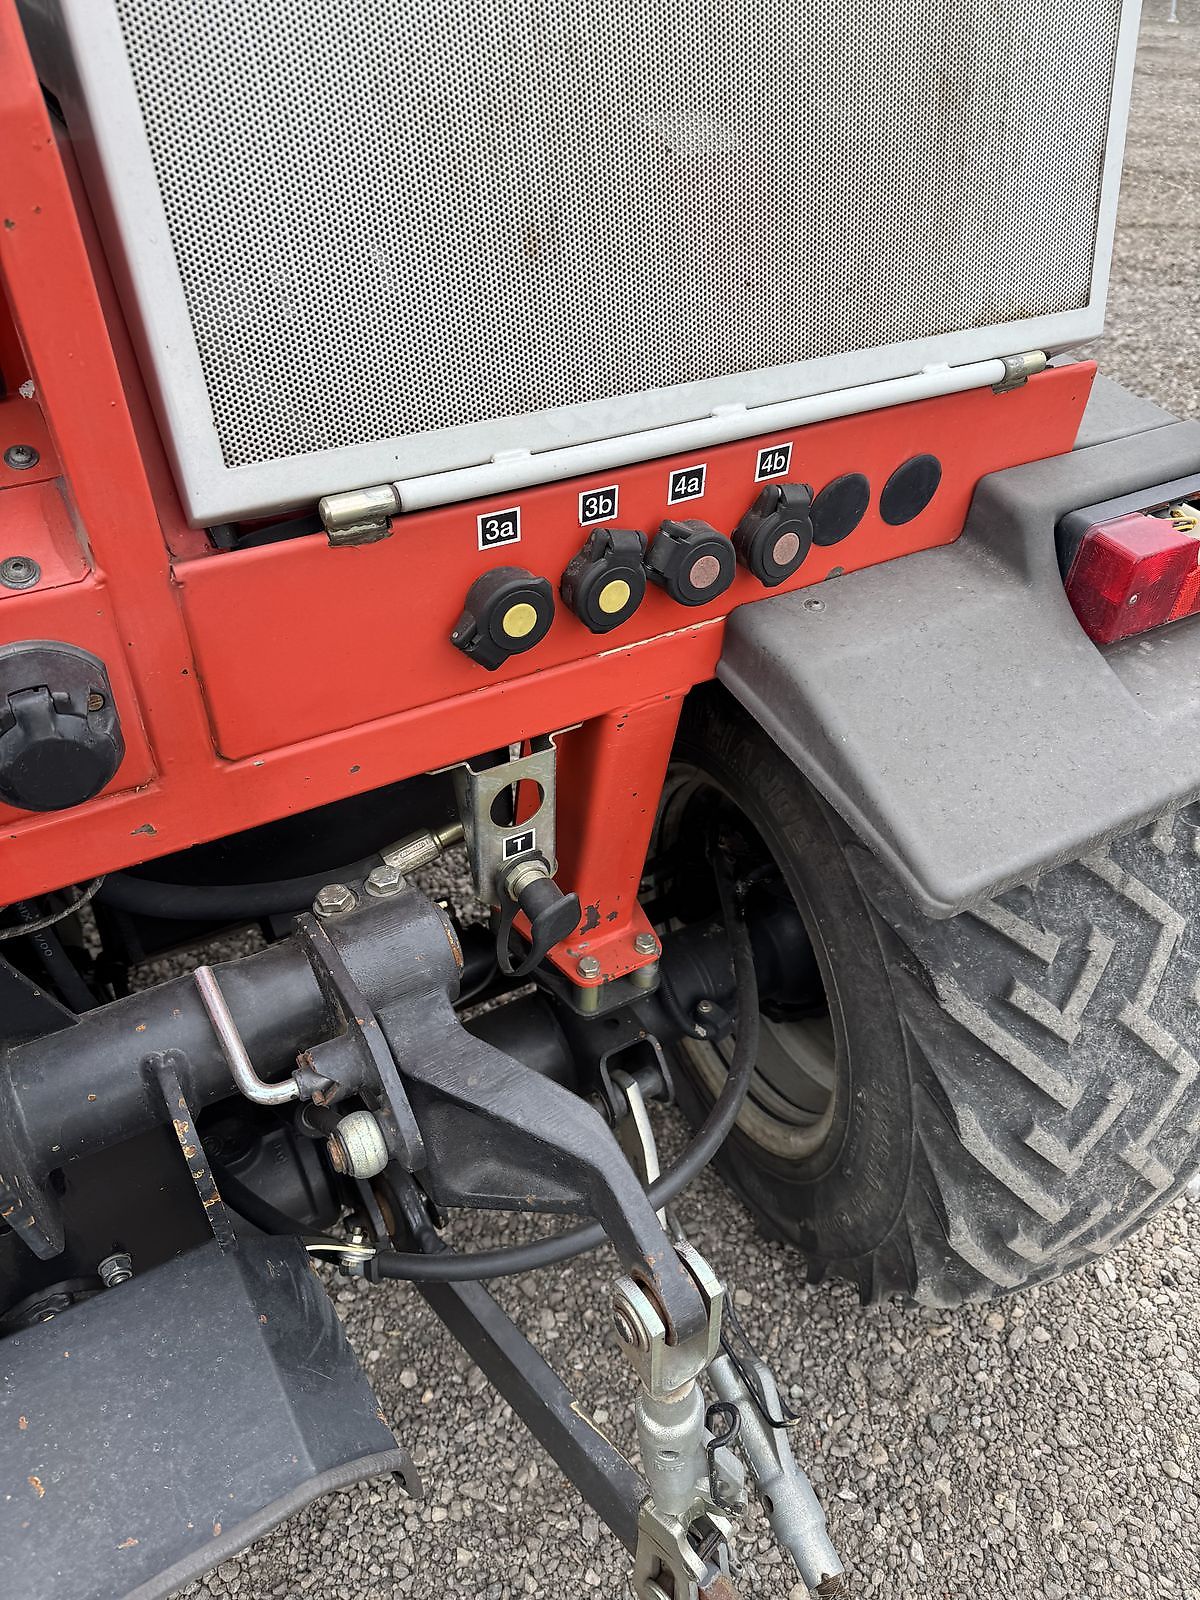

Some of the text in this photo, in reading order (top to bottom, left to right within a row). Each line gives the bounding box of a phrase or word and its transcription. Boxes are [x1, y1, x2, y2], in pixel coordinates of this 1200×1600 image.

[761, 452, 786, 474] 4b
[674, 474, 700, 496] 4a
[585, 494, 613, 518] 3b
[485, 518, 515, 542] 3a
[512, 835, 527, 852] T
